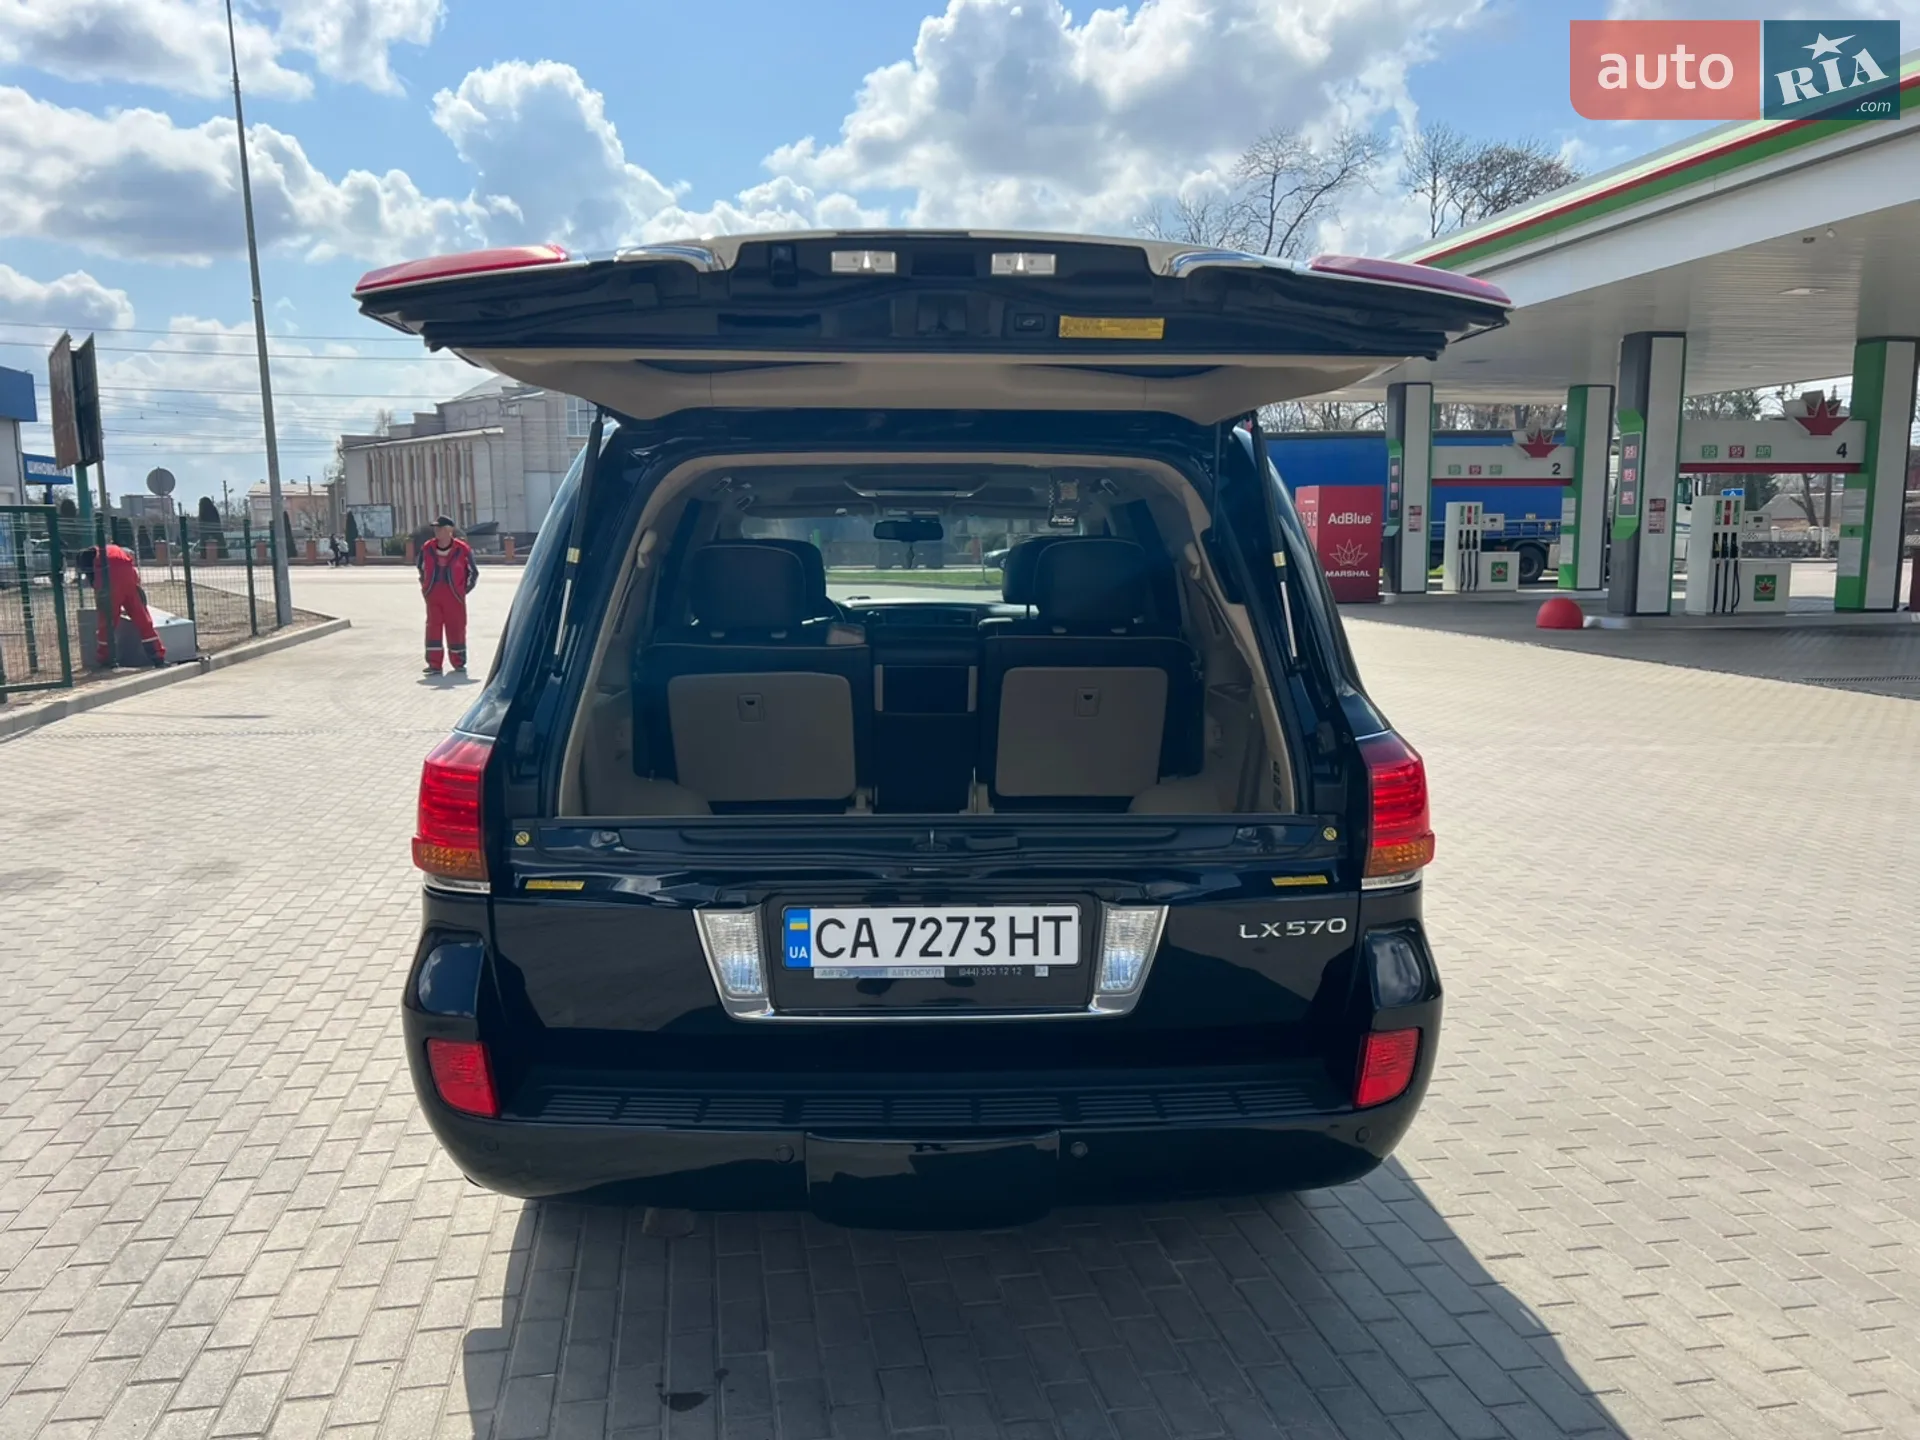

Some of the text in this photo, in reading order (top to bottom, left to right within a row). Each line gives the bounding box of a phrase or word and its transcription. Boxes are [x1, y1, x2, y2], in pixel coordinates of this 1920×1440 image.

[1731, 446, 1743, 455] 95
[1836, 442, 1848, 458] 4
[1552, 462, 1562, 475] 2
[1327, 511, 1372, 525] AdBlue
[1325, 569, 1371, 578] MARSHAL
[814, 914, 1074, 958] CA 7273 HT
[789, 945, 809, 959] UA
[999, 966, 1009, 976] 12
[1012, 966, 1023, 976] 12
